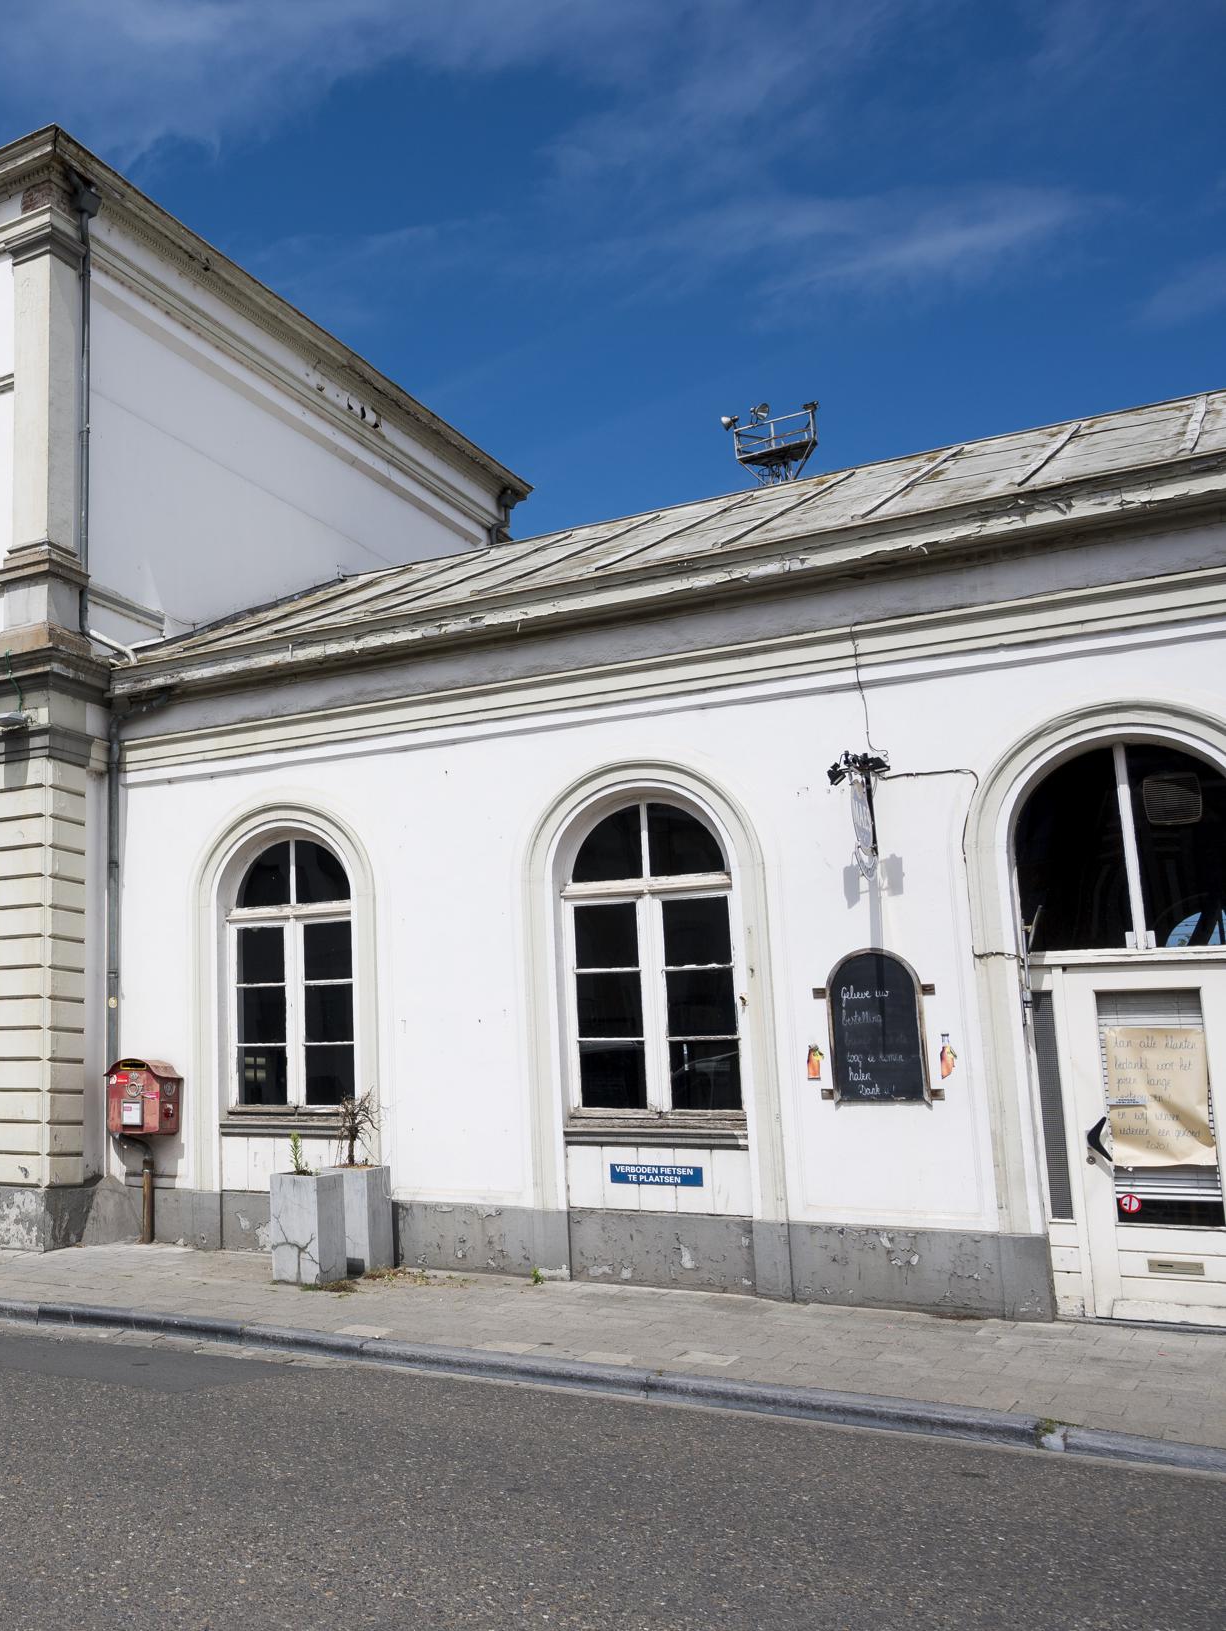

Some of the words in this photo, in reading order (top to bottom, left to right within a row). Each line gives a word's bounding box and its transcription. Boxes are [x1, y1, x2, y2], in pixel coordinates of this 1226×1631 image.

[848, 1066, 872, 1081] halen
[859, 1084, 881, 1096] Dank
[615, 1165, 659, 1174] VERBODEN
[660, 1167, 694, 1176] FIETSEN
[627, 1174, 638, 1182] TE
[639, 1175, 681, 1183] PLAATSEN
